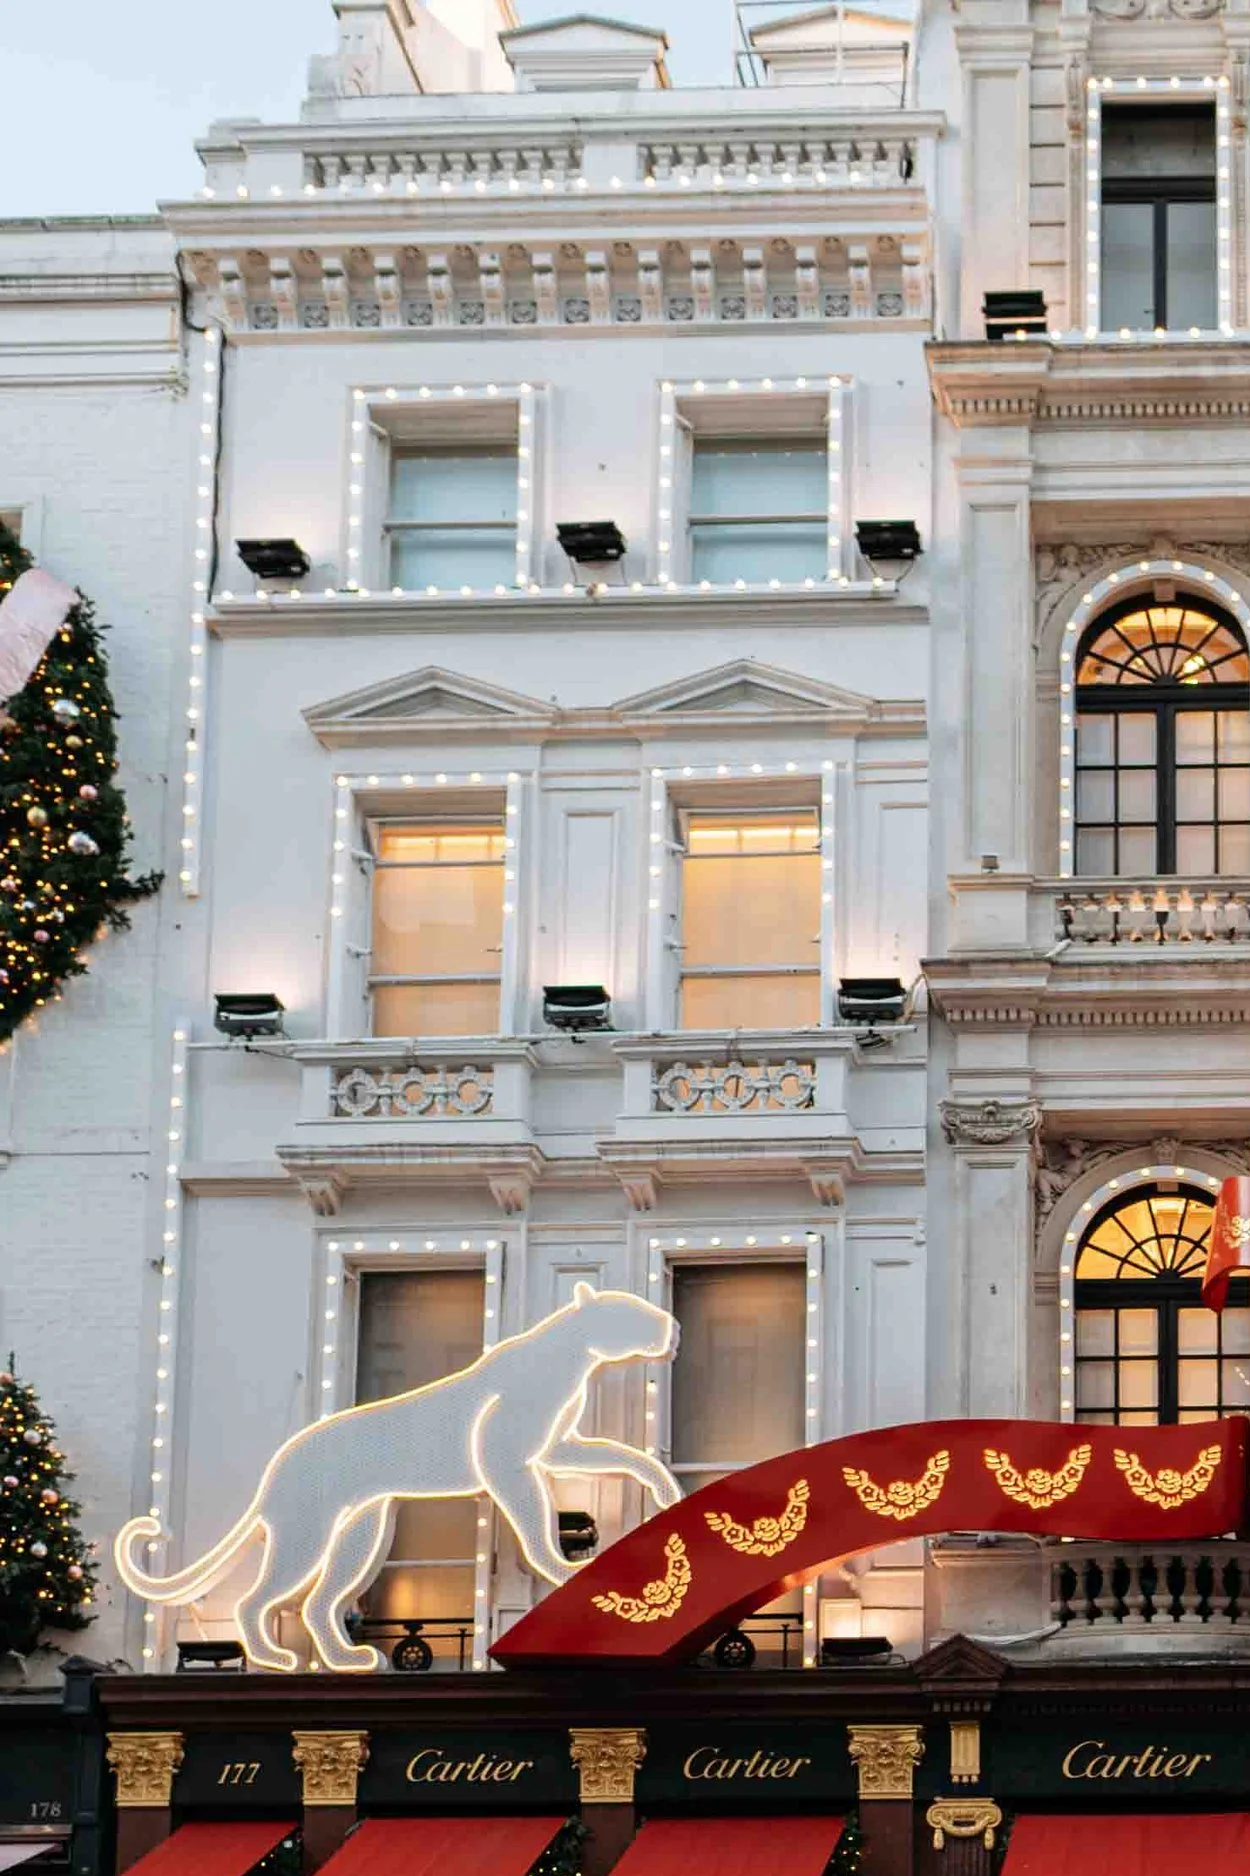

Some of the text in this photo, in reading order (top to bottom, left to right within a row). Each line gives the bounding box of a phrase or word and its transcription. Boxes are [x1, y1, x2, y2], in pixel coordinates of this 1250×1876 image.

[217, 1762, 261, 1785] 177
[405, 1748, 534, 1783] Cartier
[683, 1747, 812, 1780] Cartier
[1062, 1740, 1212, 1779] Cartier
[30, 1801, 62, 1818] 178
